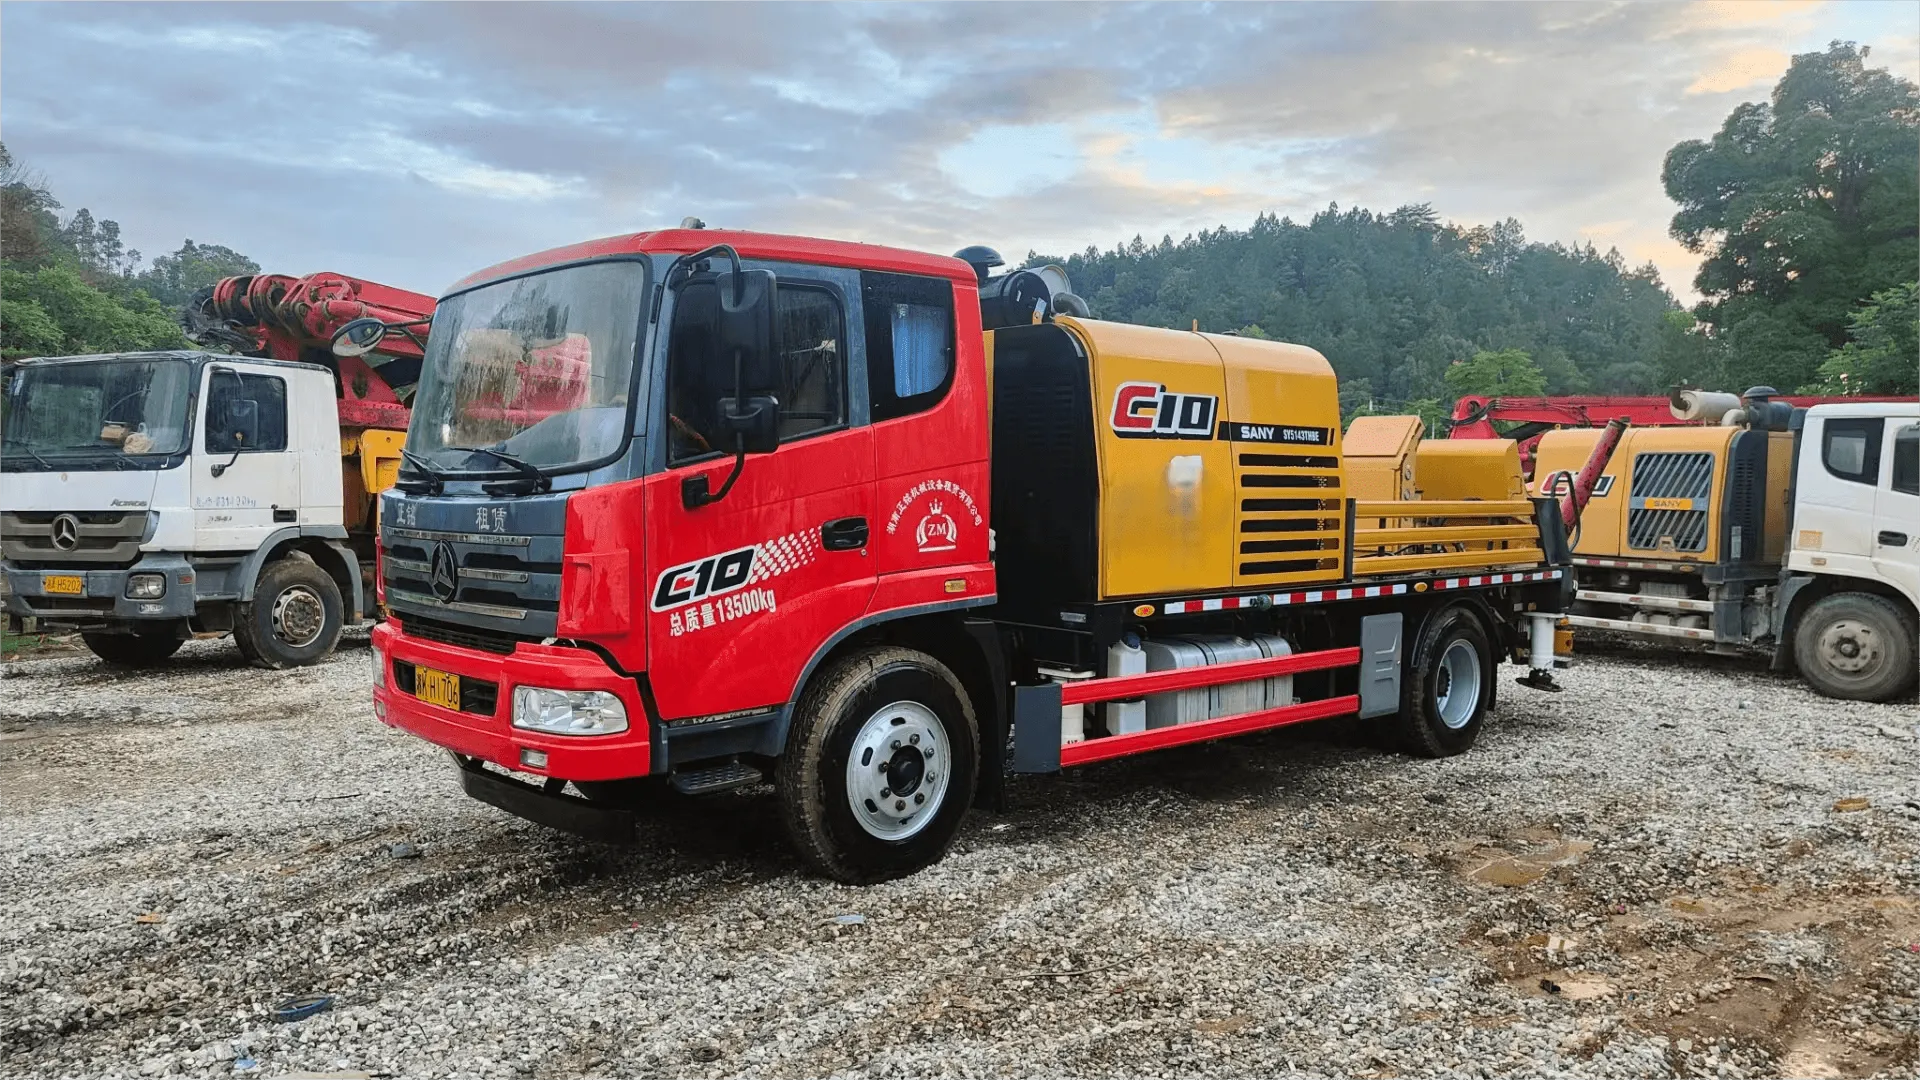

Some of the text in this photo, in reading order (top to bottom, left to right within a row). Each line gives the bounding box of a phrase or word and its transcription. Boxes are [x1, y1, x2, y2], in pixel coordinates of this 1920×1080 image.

[1110, 381, 1219, 440] C10
[1241, 426, 1274, 440] SANY
[396, 502, 507, 533] 正铭 租赁
[1653, 500, 1683, 508] SANY
[927, 523, 947, 536] ZM
[651, 545, 758, 613] C10
[669, 587, 777, 637] 总质量13500kg
